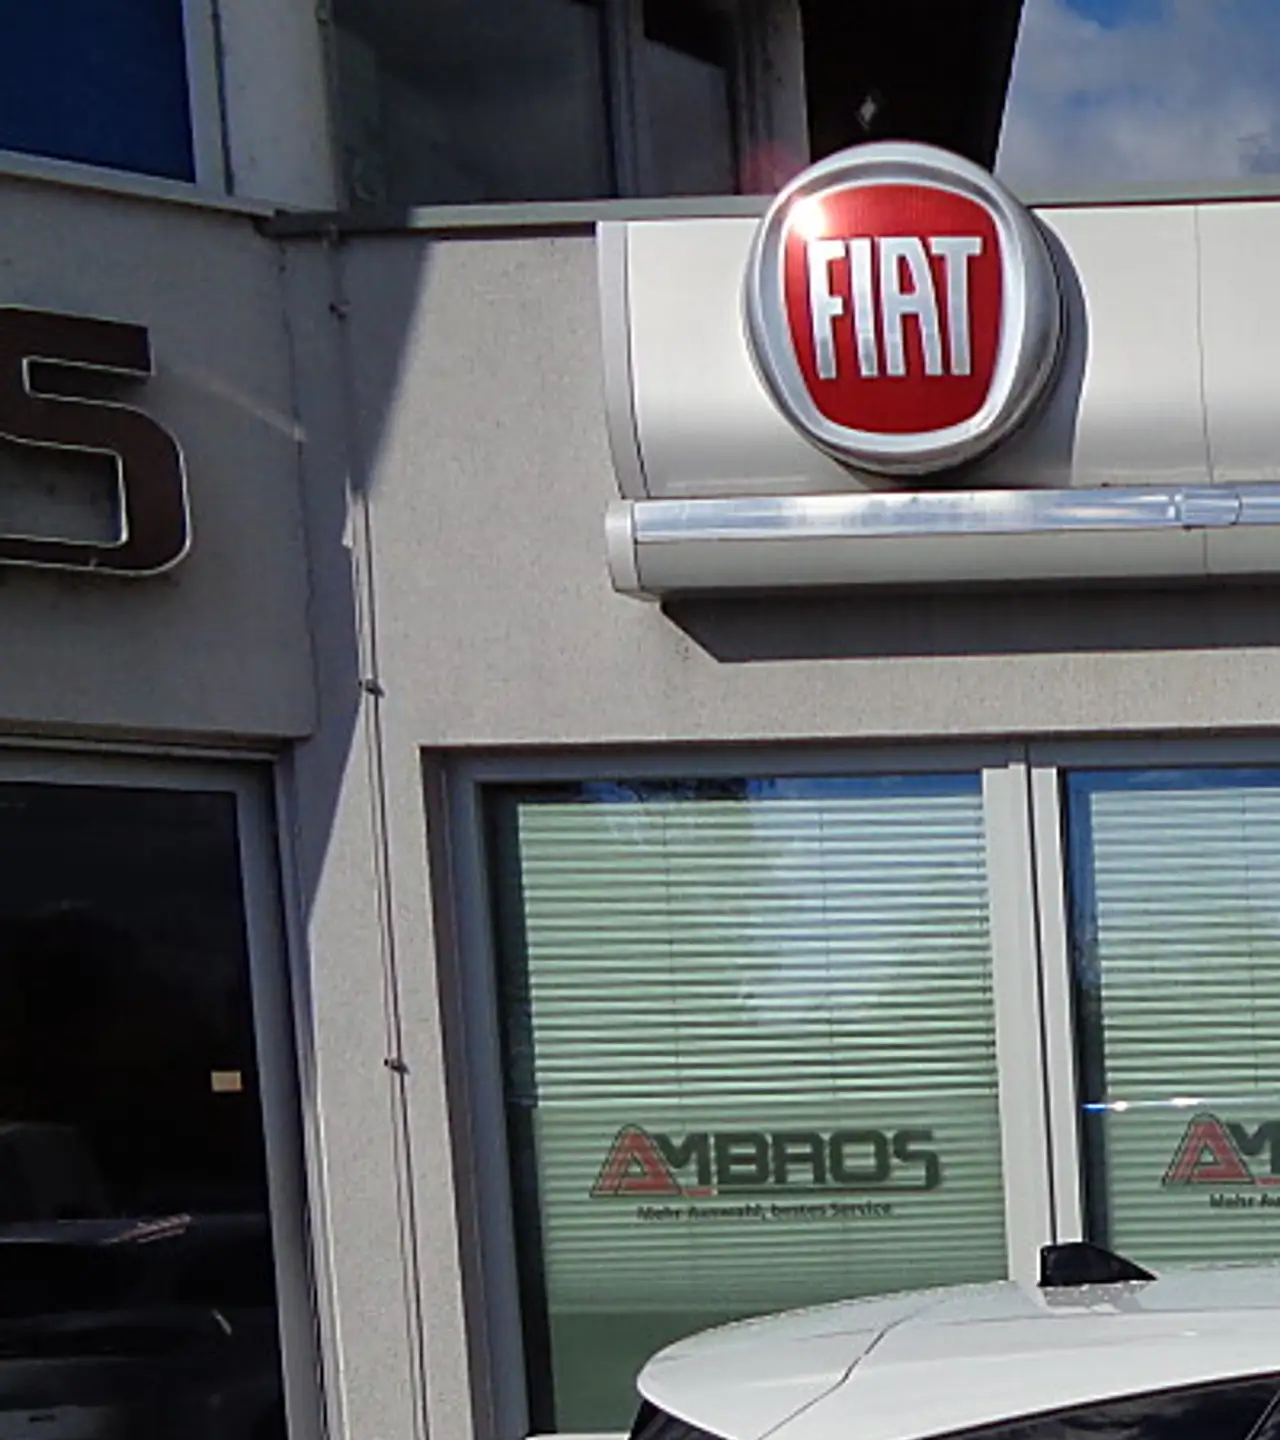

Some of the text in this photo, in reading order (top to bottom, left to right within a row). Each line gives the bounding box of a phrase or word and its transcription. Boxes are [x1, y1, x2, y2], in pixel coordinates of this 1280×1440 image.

[806, 236, 982, 380] FIAT
[589, 1123, 942, 1197] AMBROS
[636, 1204, 681, 1220] Mehr
[831, 1200, 892, 1217] Service
[1209, 1193, 1256, 1209] Mehr
